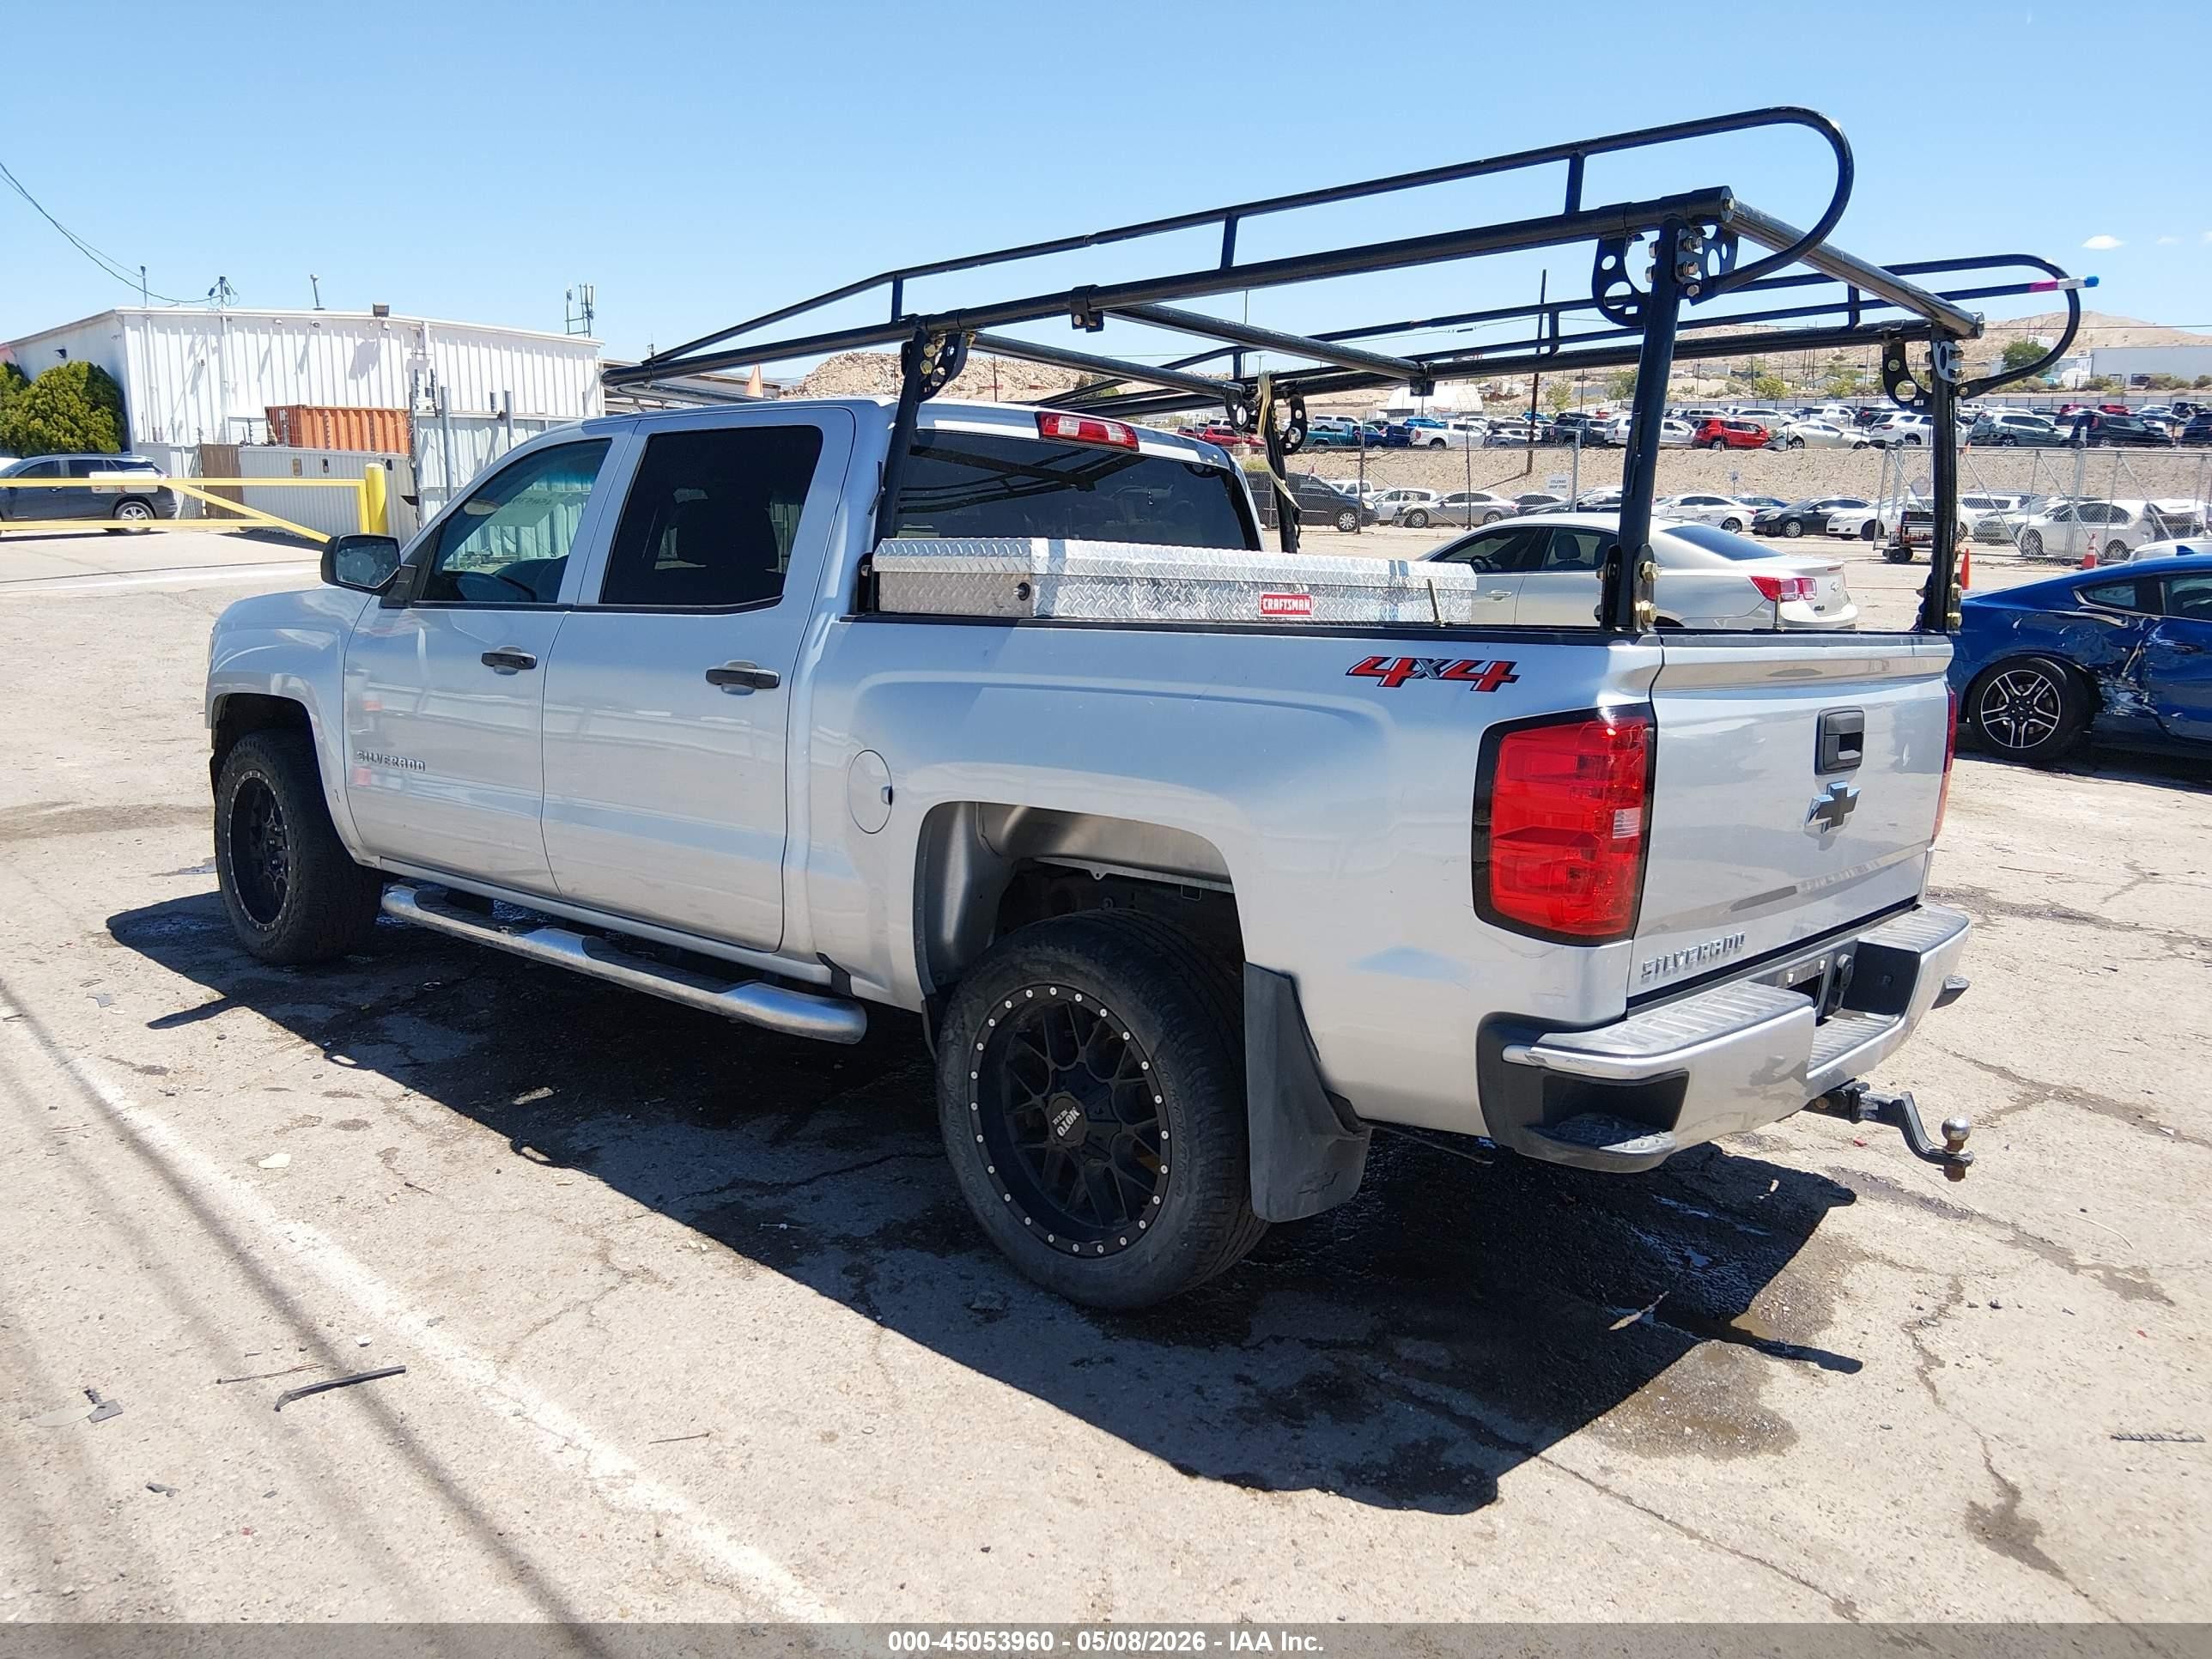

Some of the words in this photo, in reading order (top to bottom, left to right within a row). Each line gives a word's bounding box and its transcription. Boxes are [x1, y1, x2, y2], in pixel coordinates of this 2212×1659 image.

[1261, 597, 1311, 611] CRAFTSMAN
[356, 750, 426, 772] SILVERADO
[1641, 932, 1746, 979] SILVERADO
[1056, 1106, 1081, 1138] MOTO
